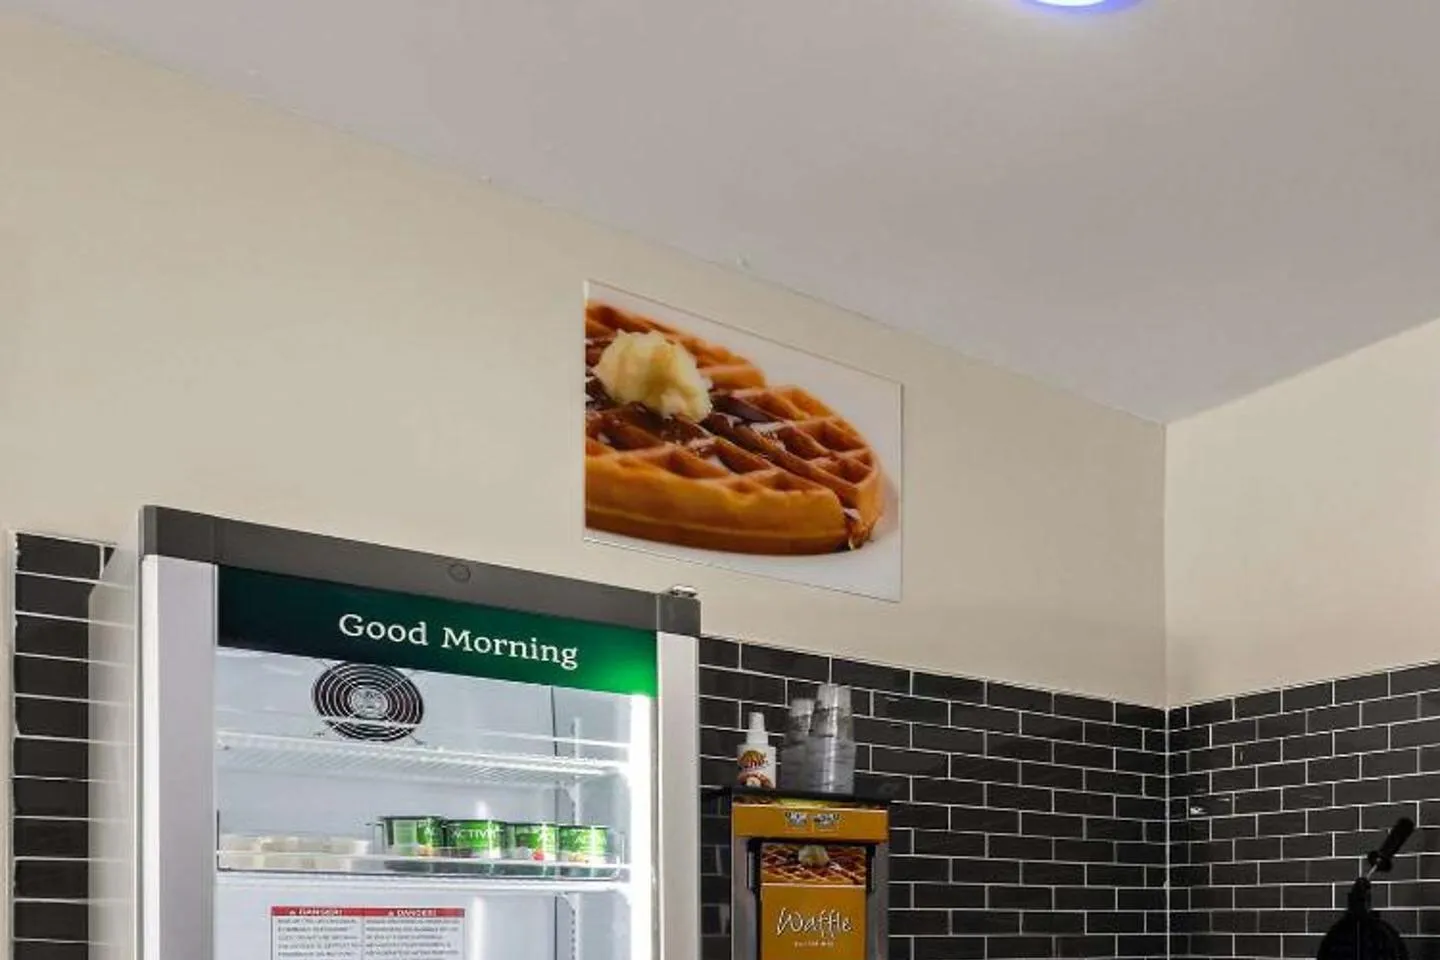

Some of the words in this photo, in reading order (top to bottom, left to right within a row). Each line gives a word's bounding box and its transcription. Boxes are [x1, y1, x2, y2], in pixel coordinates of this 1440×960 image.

[338, 612, 429, 646] Good
[440, 626, 579, 671] Morning
[776, 907, 853, 938] Waffle
